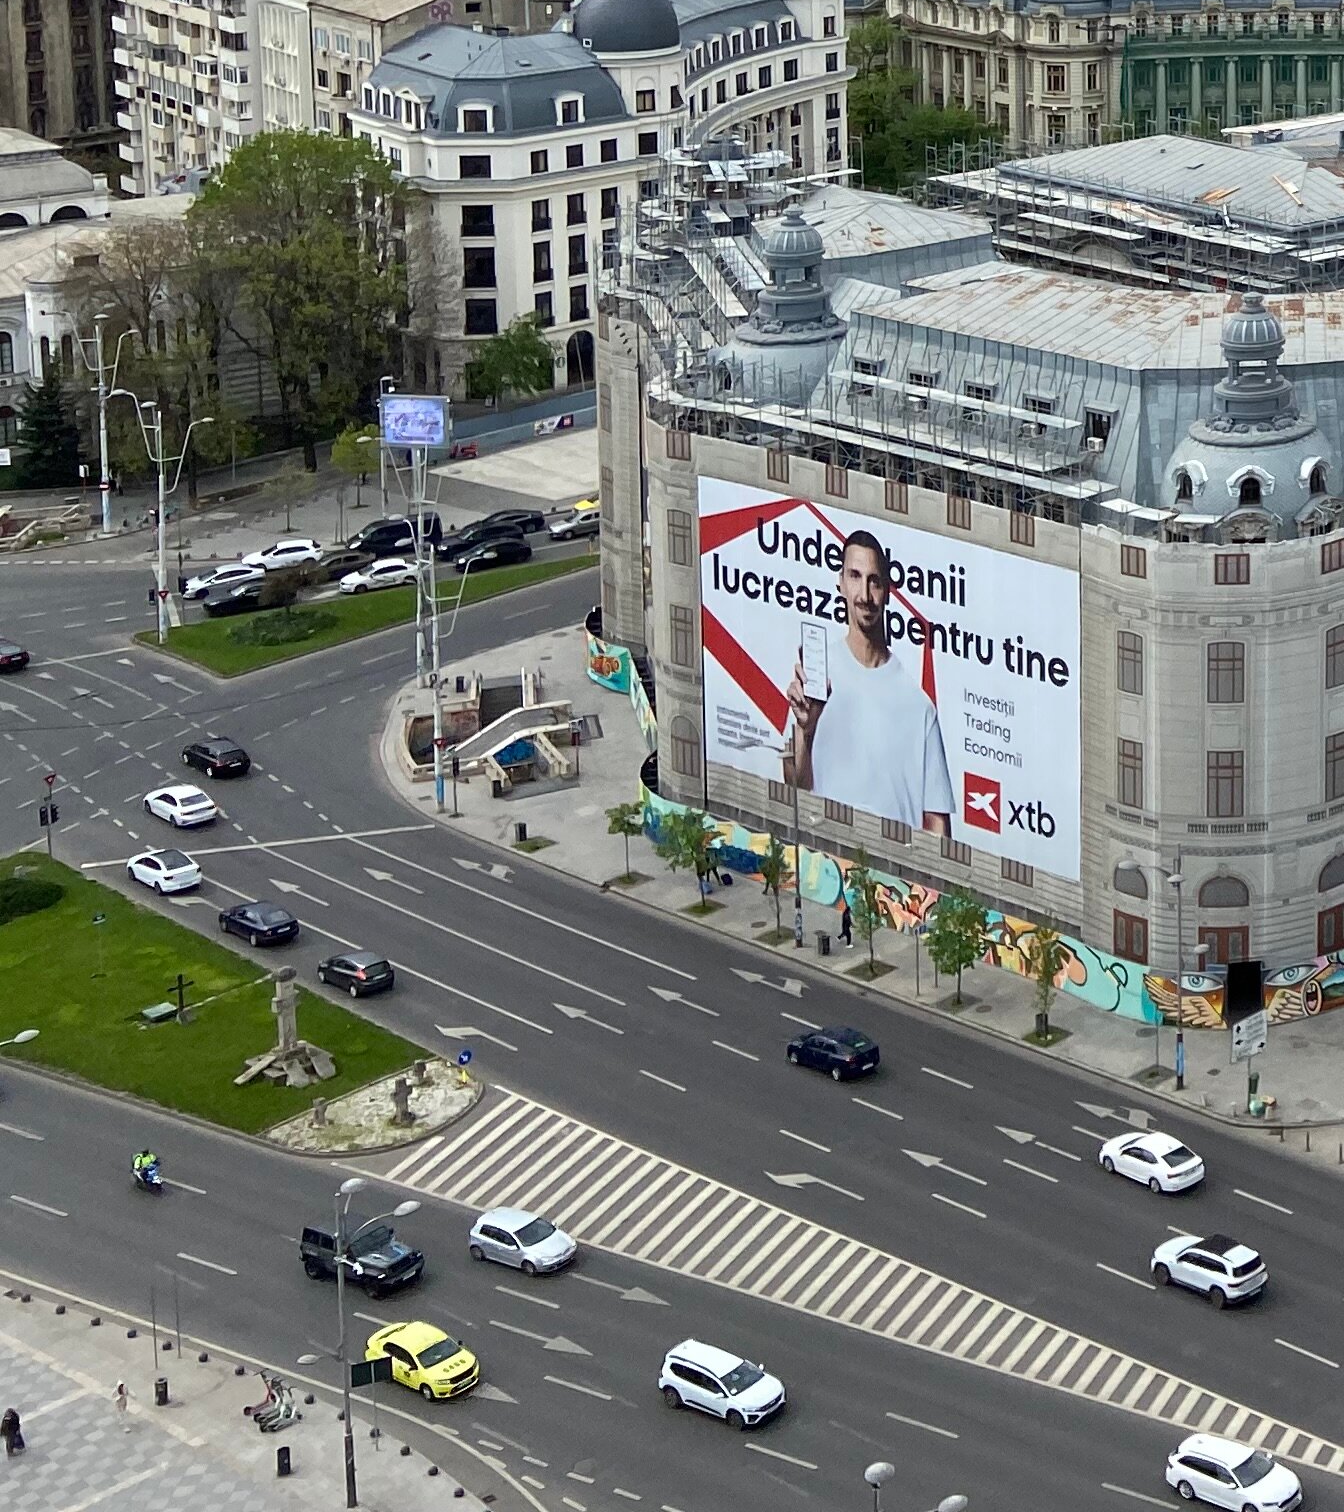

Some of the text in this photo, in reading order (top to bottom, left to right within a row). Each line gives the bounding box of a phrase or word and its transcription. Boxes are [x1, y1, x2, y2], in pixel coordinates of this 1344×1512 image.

[757, 517, 844, 572] Unde
[885, 548, 966, 607] banii
[885, 609, 994, 666] pentru
[1003, 635, 1070, 688] tine
[964, 687, 1015, 718] Investiții
[964, 712, 1011, 744] Trading
[964, 737, 1023, 769] Economii
[1008, 800, 1056, 839] xtb
